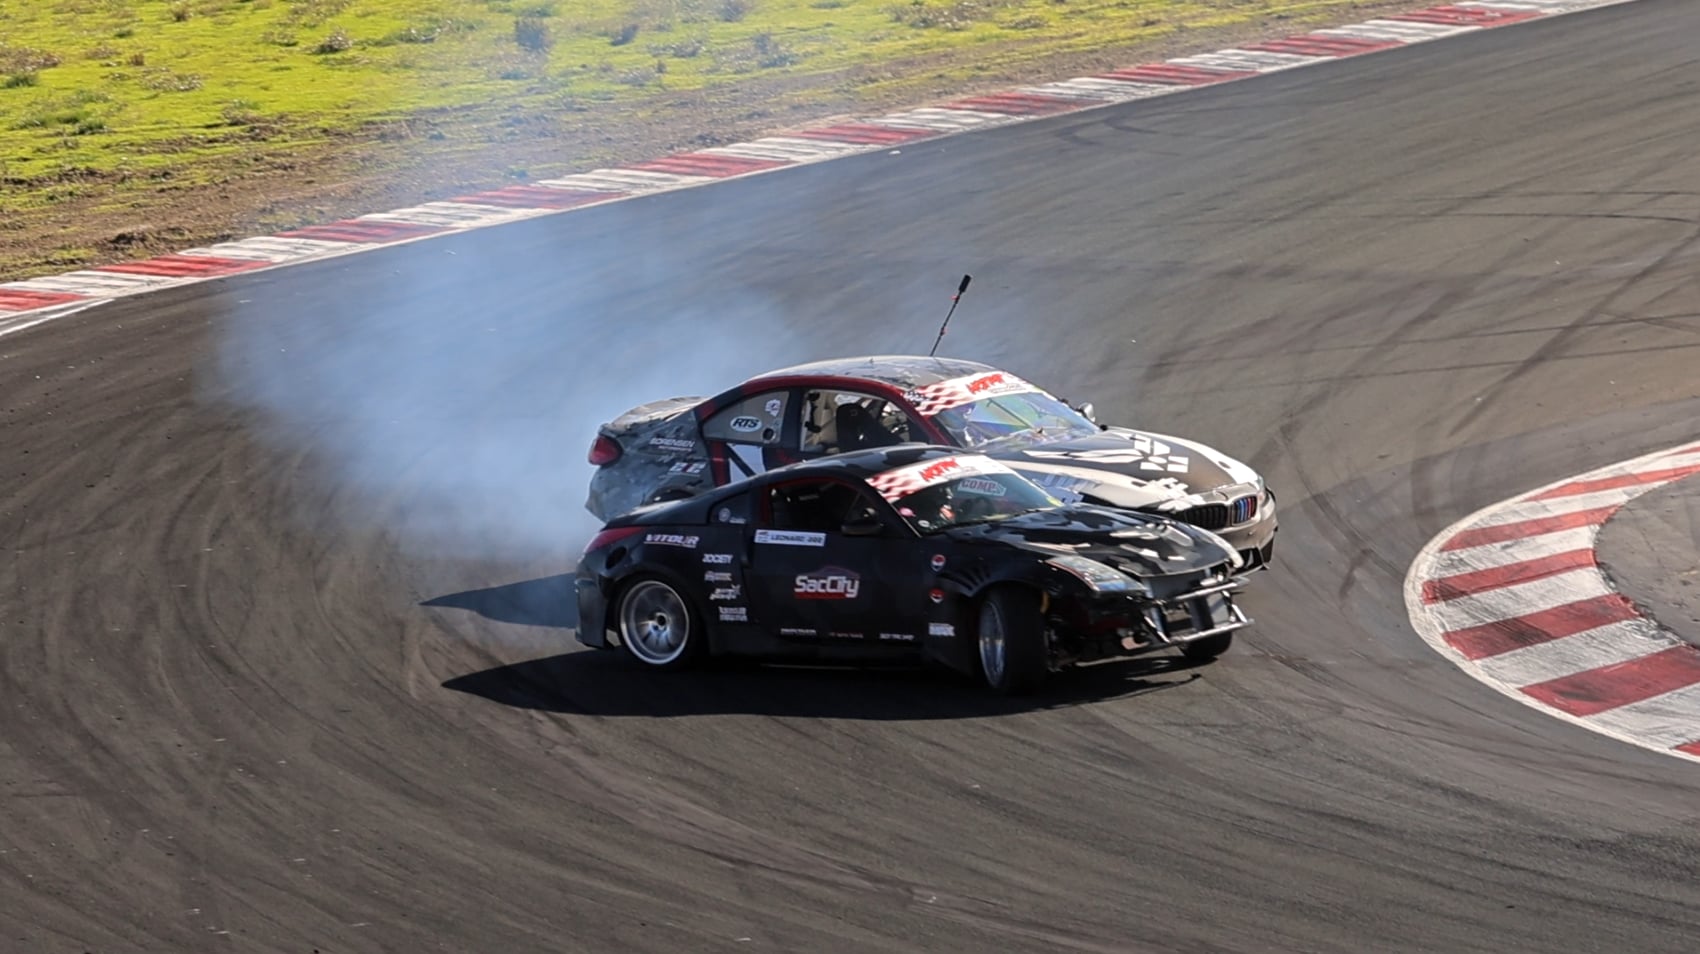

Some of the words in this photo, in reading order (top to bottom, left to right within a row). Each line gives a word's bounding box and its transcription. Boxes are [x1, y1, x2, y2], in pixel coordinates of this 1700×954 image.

[733, 418, 760, 428] RTS
[645, 533, 700, 546] VITOUR
[793, 574, 860, 599] SacCity
